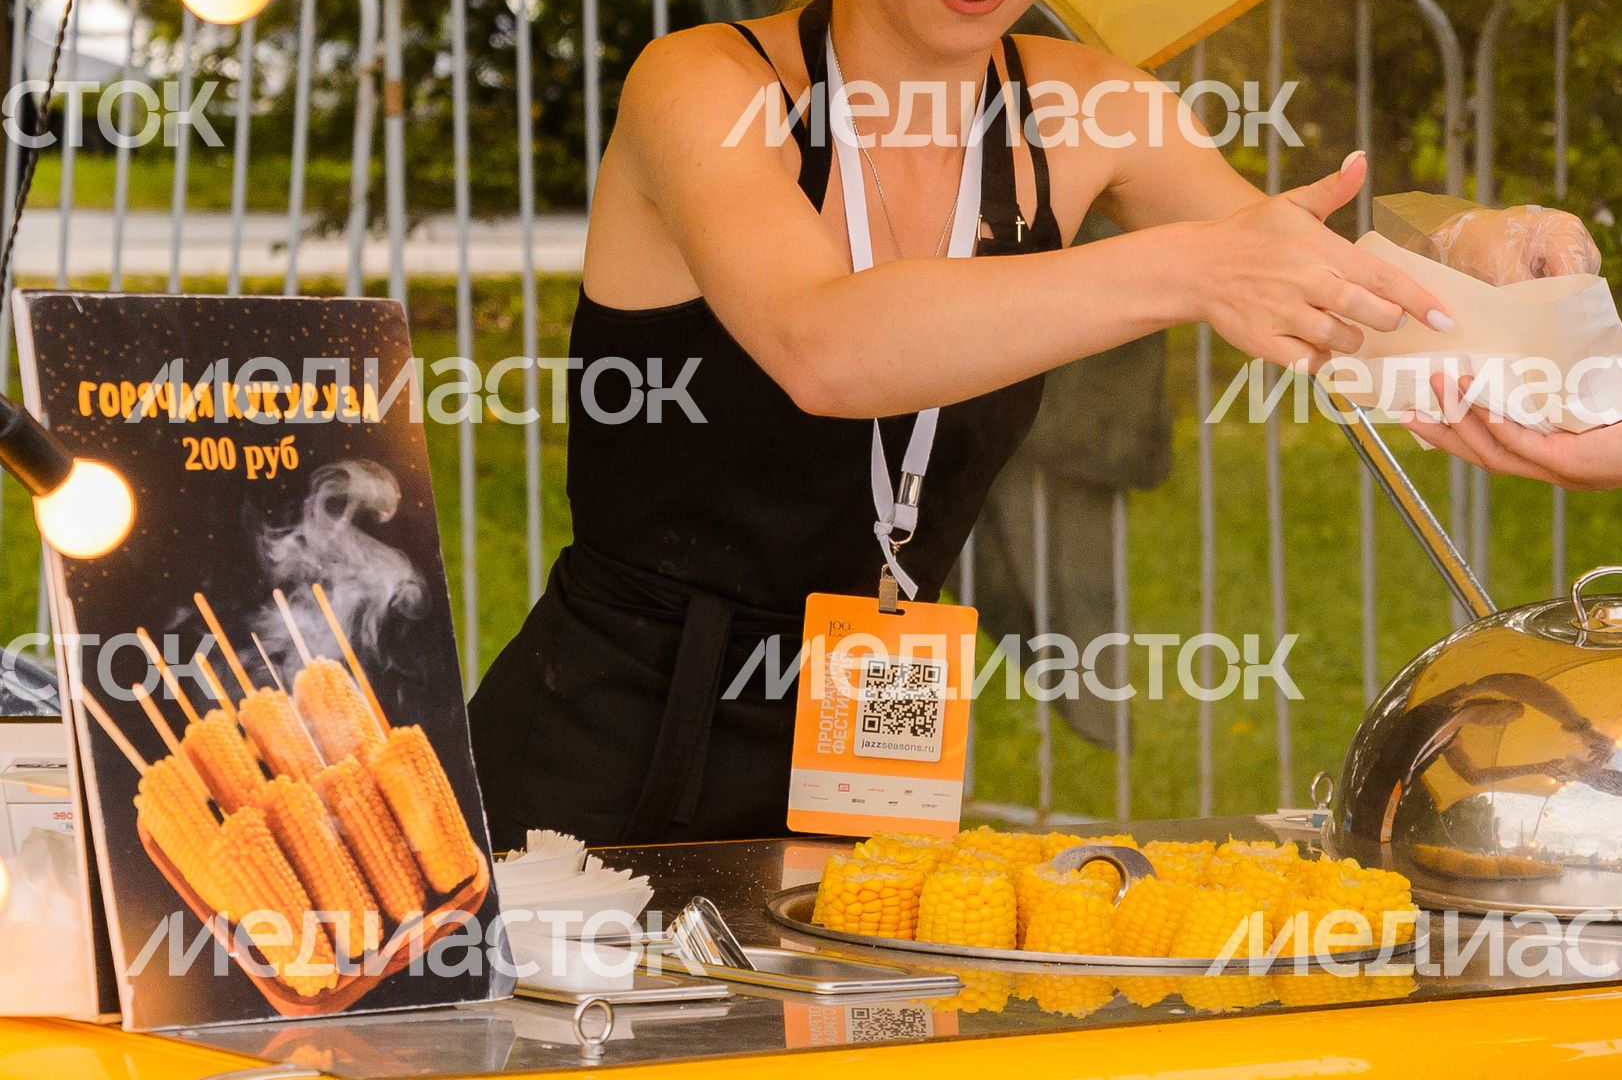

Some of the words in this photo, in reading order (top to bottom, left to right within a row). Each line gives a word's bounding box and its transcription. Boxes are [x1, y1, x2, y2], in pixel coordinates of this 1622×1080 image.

[78, 380, 215, 422] ГОРЯЧАЯ
[221, 380, 380, 422] КУКУРУЗА
[182, 435, 237, 471] 200
[243, 434, 300, 480] руб
[861, 738, 935, 754] jazzseasons.ru
